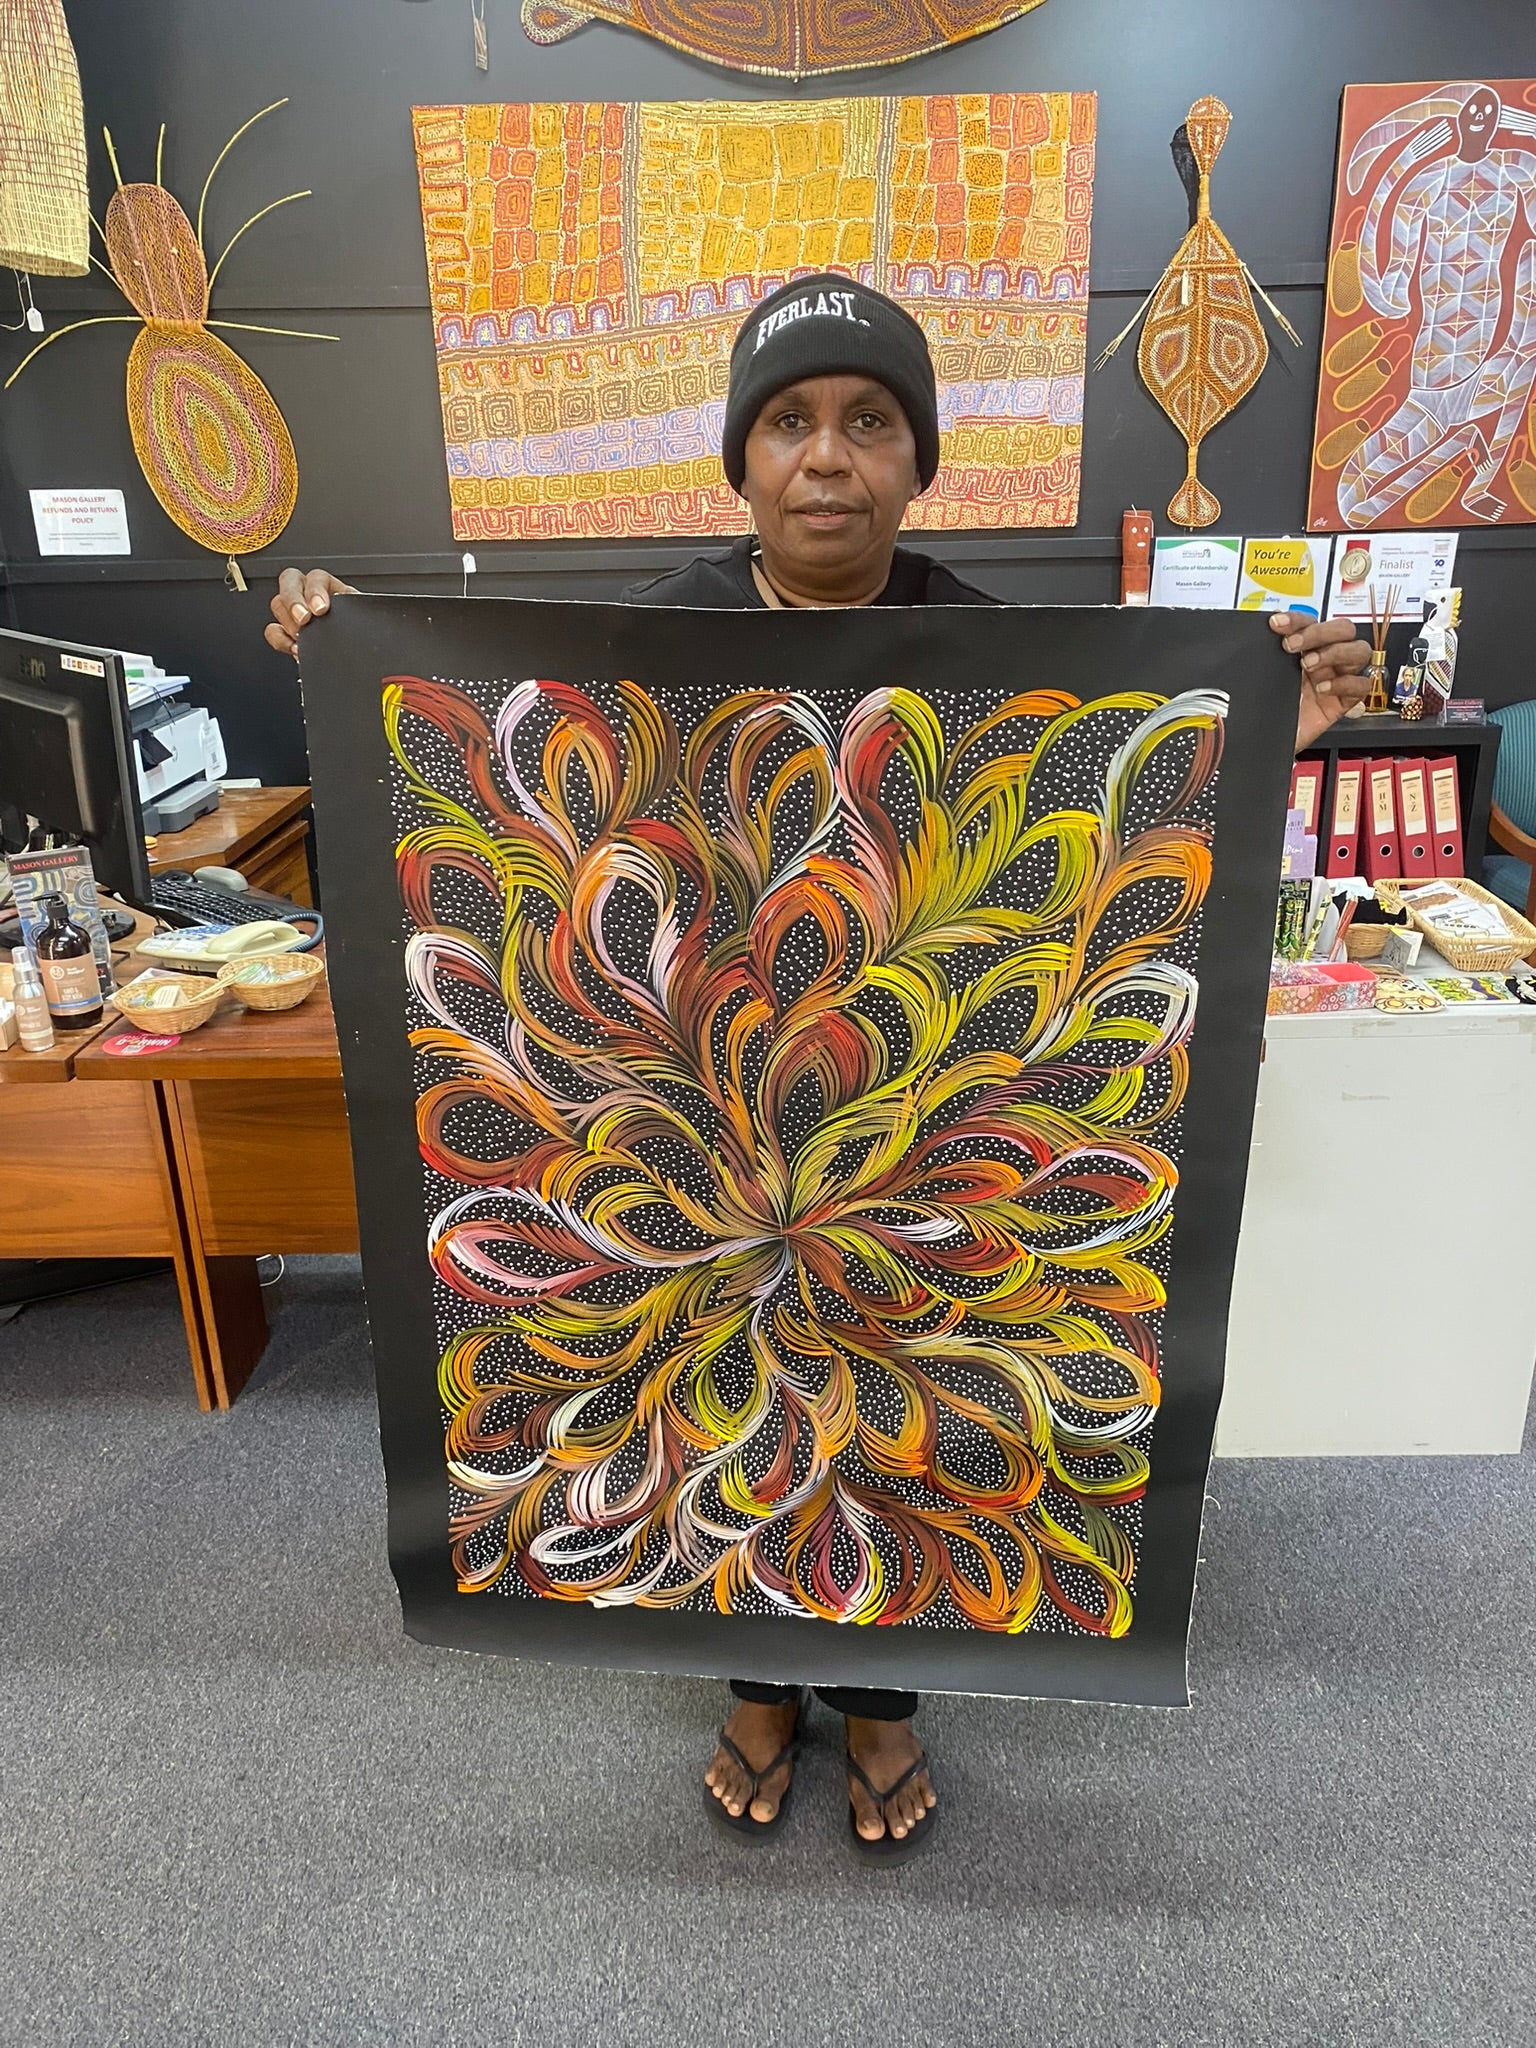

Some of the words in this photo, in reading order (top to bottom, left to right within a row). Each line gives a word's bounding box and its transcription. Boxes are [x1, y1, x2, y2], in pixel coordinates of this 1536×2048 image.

[753, 292, 857, 355] EVERLAST
[1254, 549, 1291, 560] You're
[1197, 564, 1228, 572] Membership
[1379, 560, 1414, 570] Finalist
[1250, 565, 1306, 575] Awesome
[1379, 792, 1386, 801] H
[1409, 793, 1416, 801] N
[1379, 803, 1387, 811] M
[1411, 804, 1418, 812] Z
[13, 859, 42, 870] MASON
[42, 855, 78, 867] GALLERY
